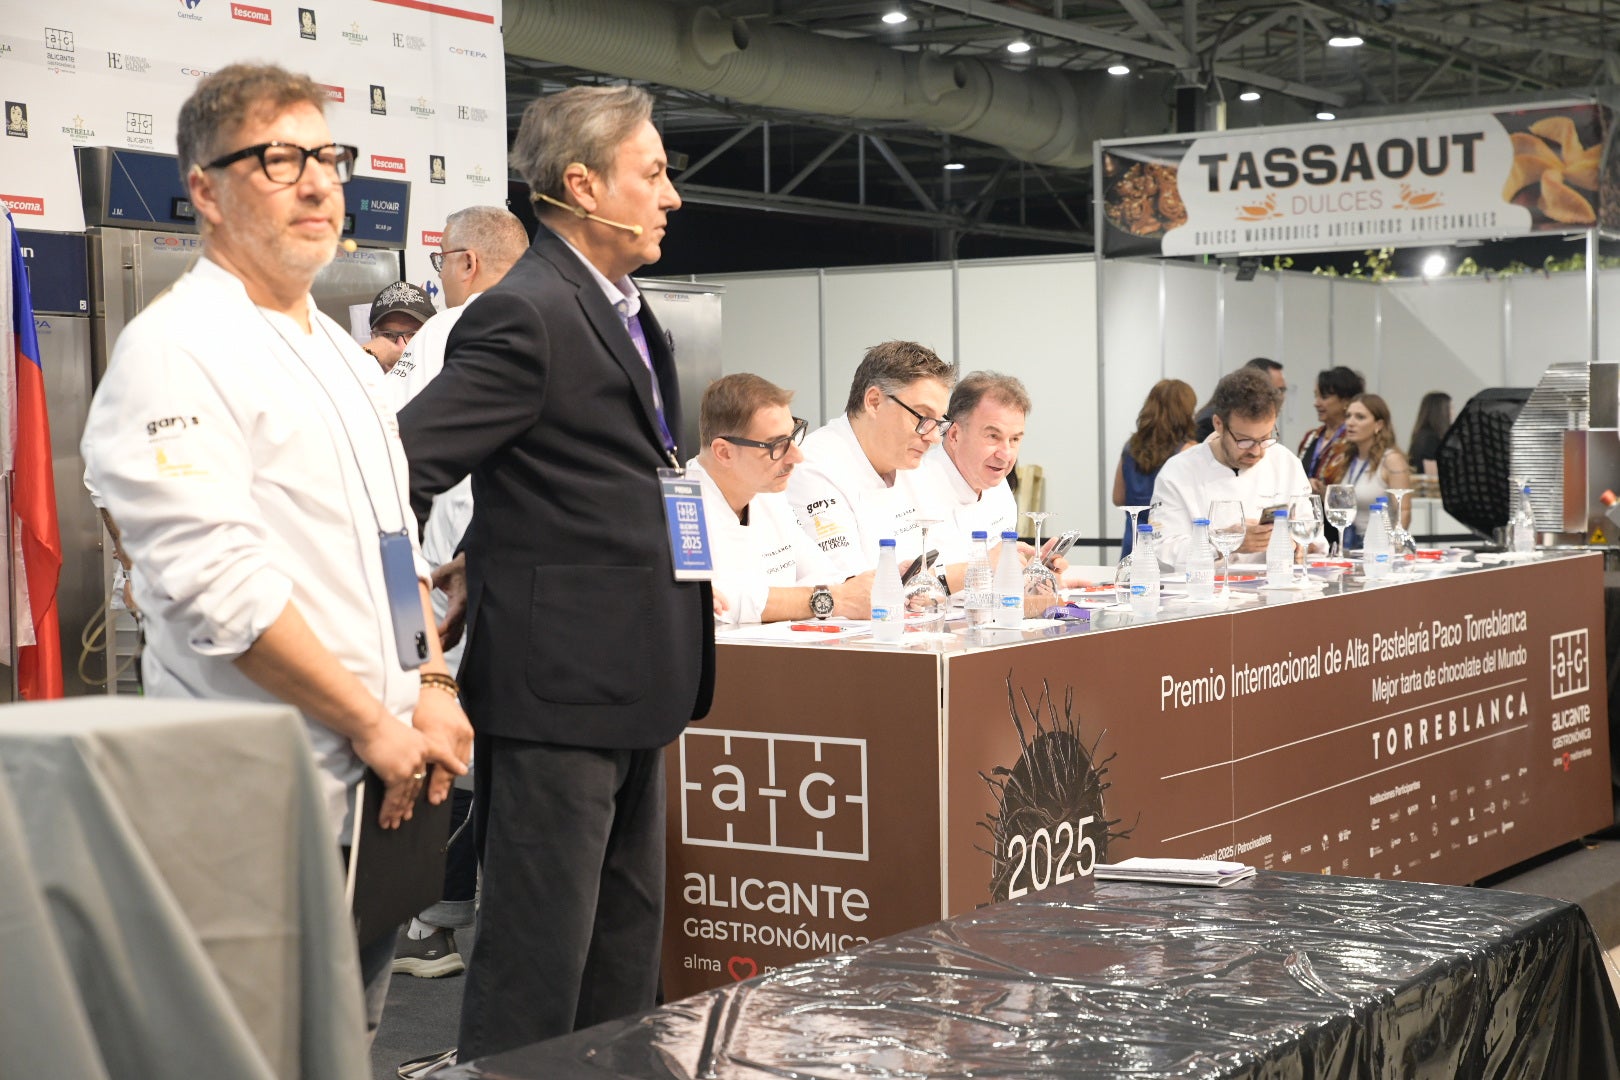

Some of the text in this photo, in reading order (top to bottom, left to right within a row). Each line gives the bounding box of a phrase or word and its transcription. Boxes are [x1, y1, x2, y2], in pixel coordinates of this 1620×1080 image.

[177, 11, 203, 21] Carrefour
[449, 46, 487, 59] COTEPA
[61, 126, 95, 137] ESTRELLA
[1197, 132, 1486, 193] TASSAOUT
[4, 200, 42, 212] escoma.
[1291, 190, 1383, 215] DULCES
[153, 236, 197, 248] COTE
[681, 536, 702, 549] 2025
[1161, 608, 1528, 711] Premio Internacional de Alta Pastelería Paco Torreblanca
[1556, 651, 1566, 679] a
[1372, 645, 1528, 705] Mejor tarta de chocolate del Mundo
[1372, 691, 1529, 760] TORREBLANCA
[711, 764, 836, 819] a G
[1007, 815, 1096, 900] 2025
[1218, 846, 1234, 860] 2025
[1237, 834, 1272, 854] Patrocinadores
[683, 954, 721, 972] alma
